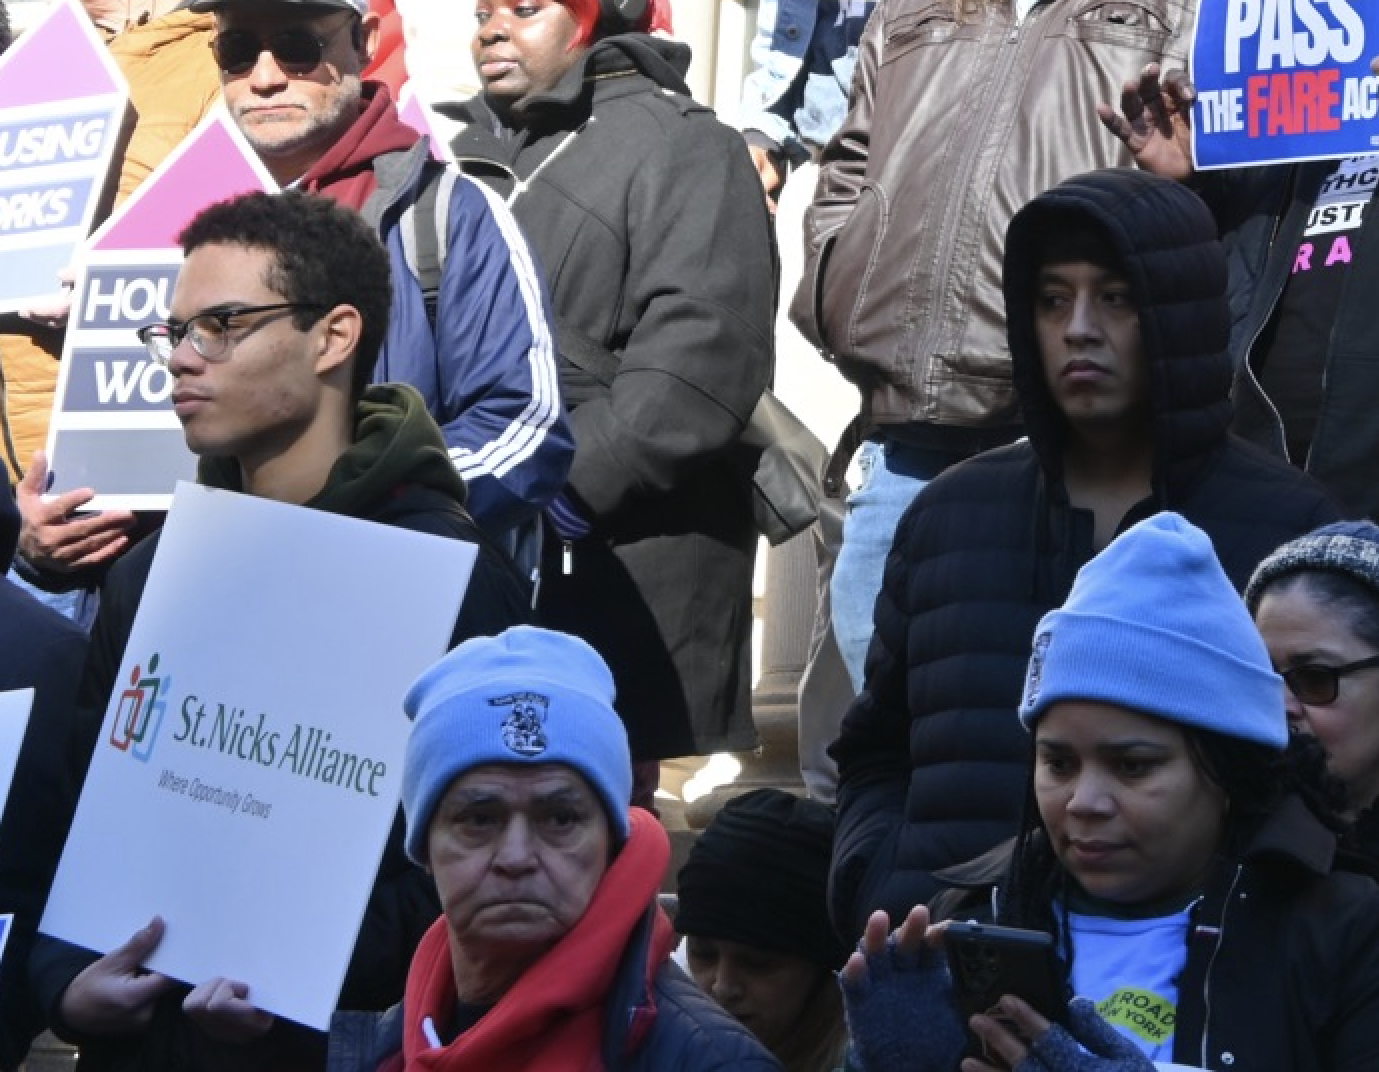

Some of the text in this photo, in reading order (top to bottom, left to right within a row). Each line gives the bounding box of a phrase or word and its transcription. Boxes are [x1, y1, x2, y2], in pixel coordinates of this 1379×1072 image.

[1197, 88, 1244, 134] THE
[1246, 69, 1341, 139] FARE
[157, 769, 273, 819] Where Opportunity Grows
[277, 723, 388, 797] Alliance
